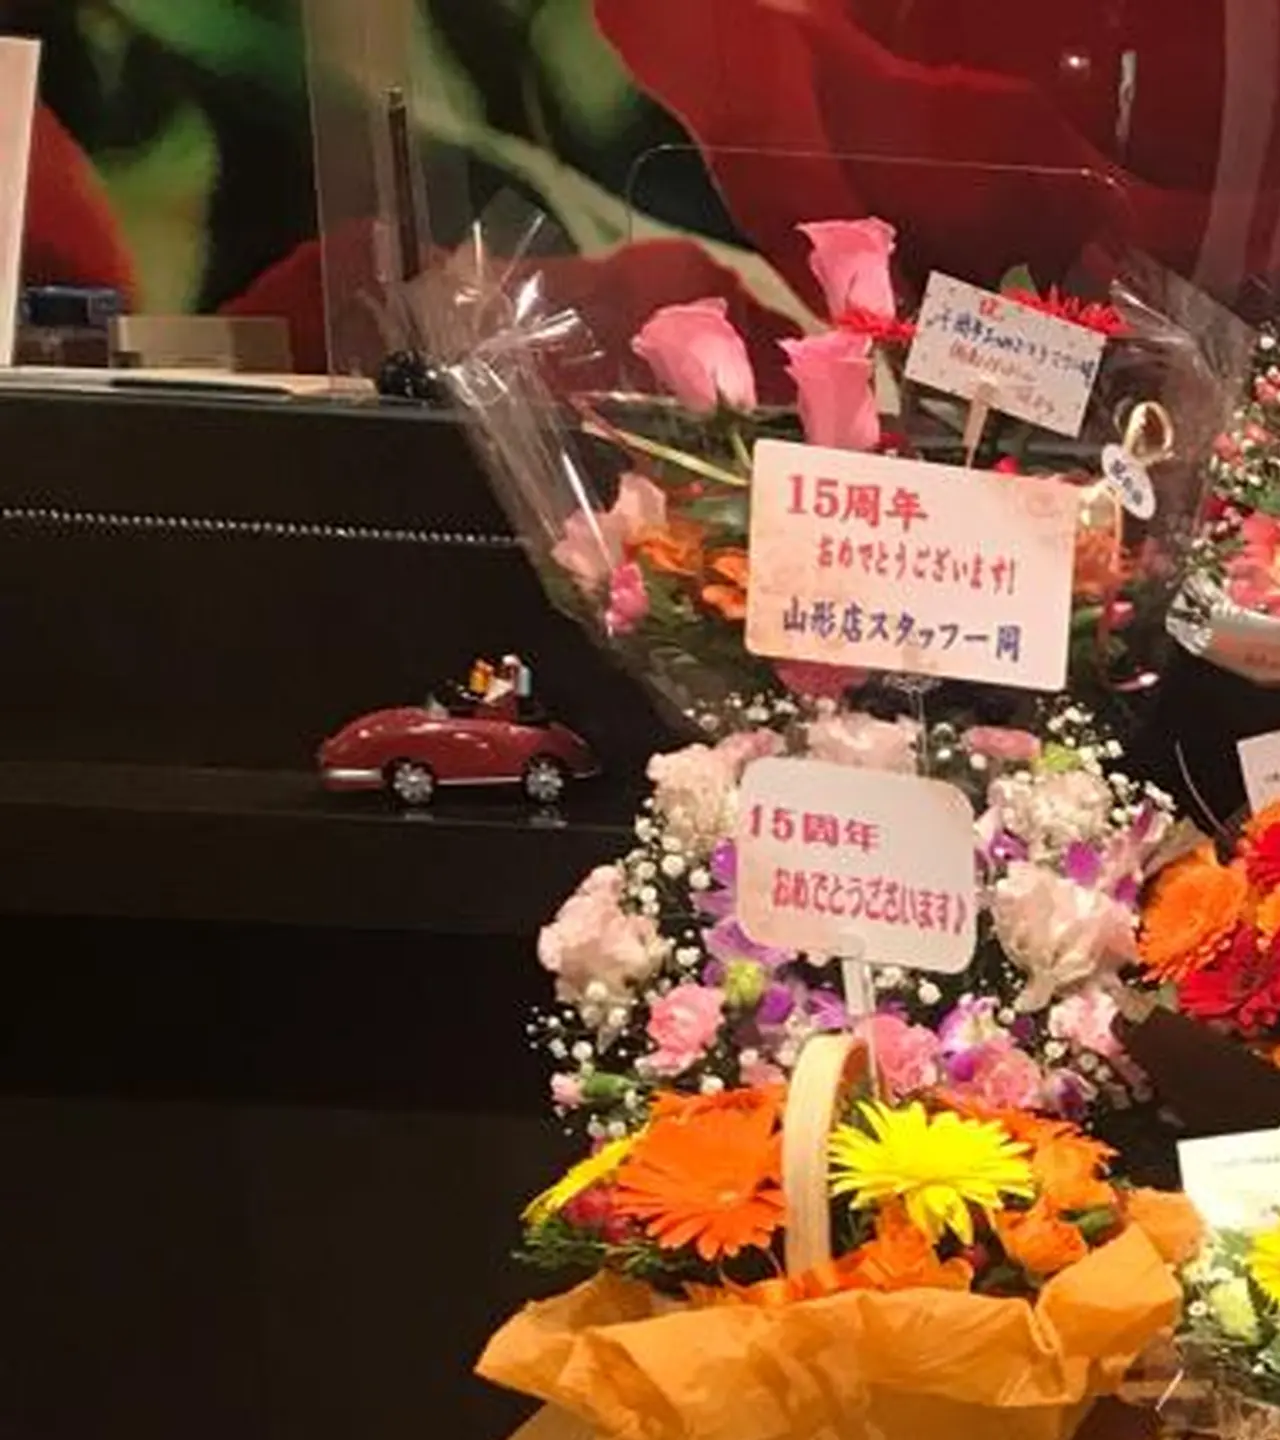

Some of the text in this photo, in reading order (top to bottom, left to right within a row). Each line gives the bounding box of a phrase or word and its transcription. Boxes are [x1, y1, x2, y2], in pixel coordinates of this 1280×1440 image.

[786, 473, 929, 531] 15周年
[782, 596, 1022, 664] 山形店スタッフ一同
[748, 803, 881, 852] 15周年
